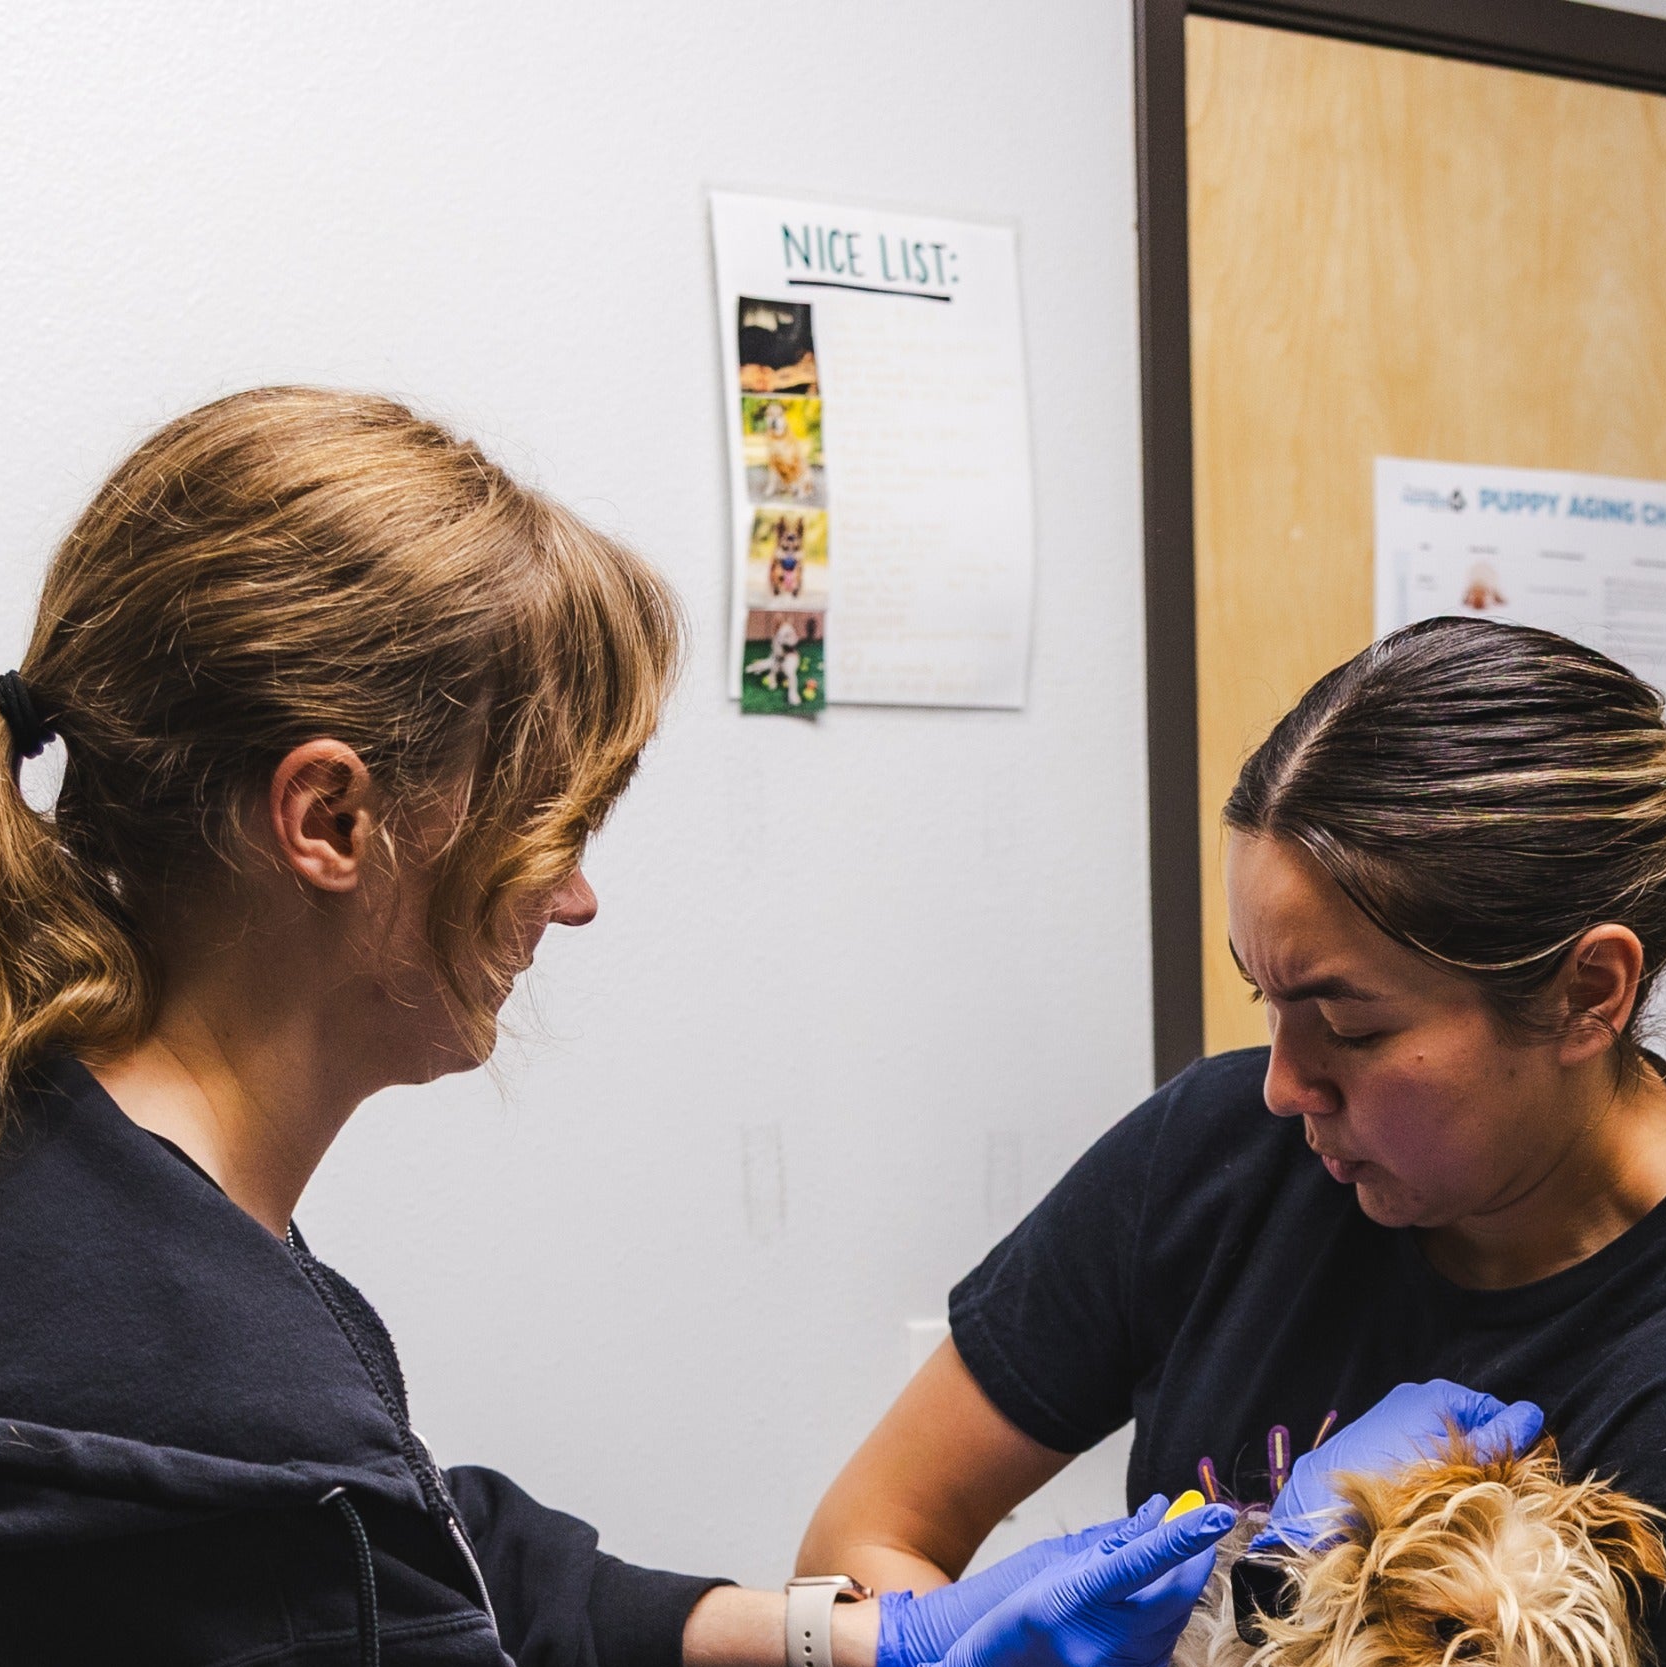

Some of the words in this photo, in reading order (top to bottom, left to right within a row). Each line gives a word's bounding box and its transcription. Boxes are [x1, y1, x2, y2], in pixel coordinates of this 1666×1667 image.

[781, 222, 865, 278] NICE
[878, 233, 959, 286] LIST:
[1479, 488, 1560, 515] PUPPY
[1568, 495, 1634, 523] AGING
